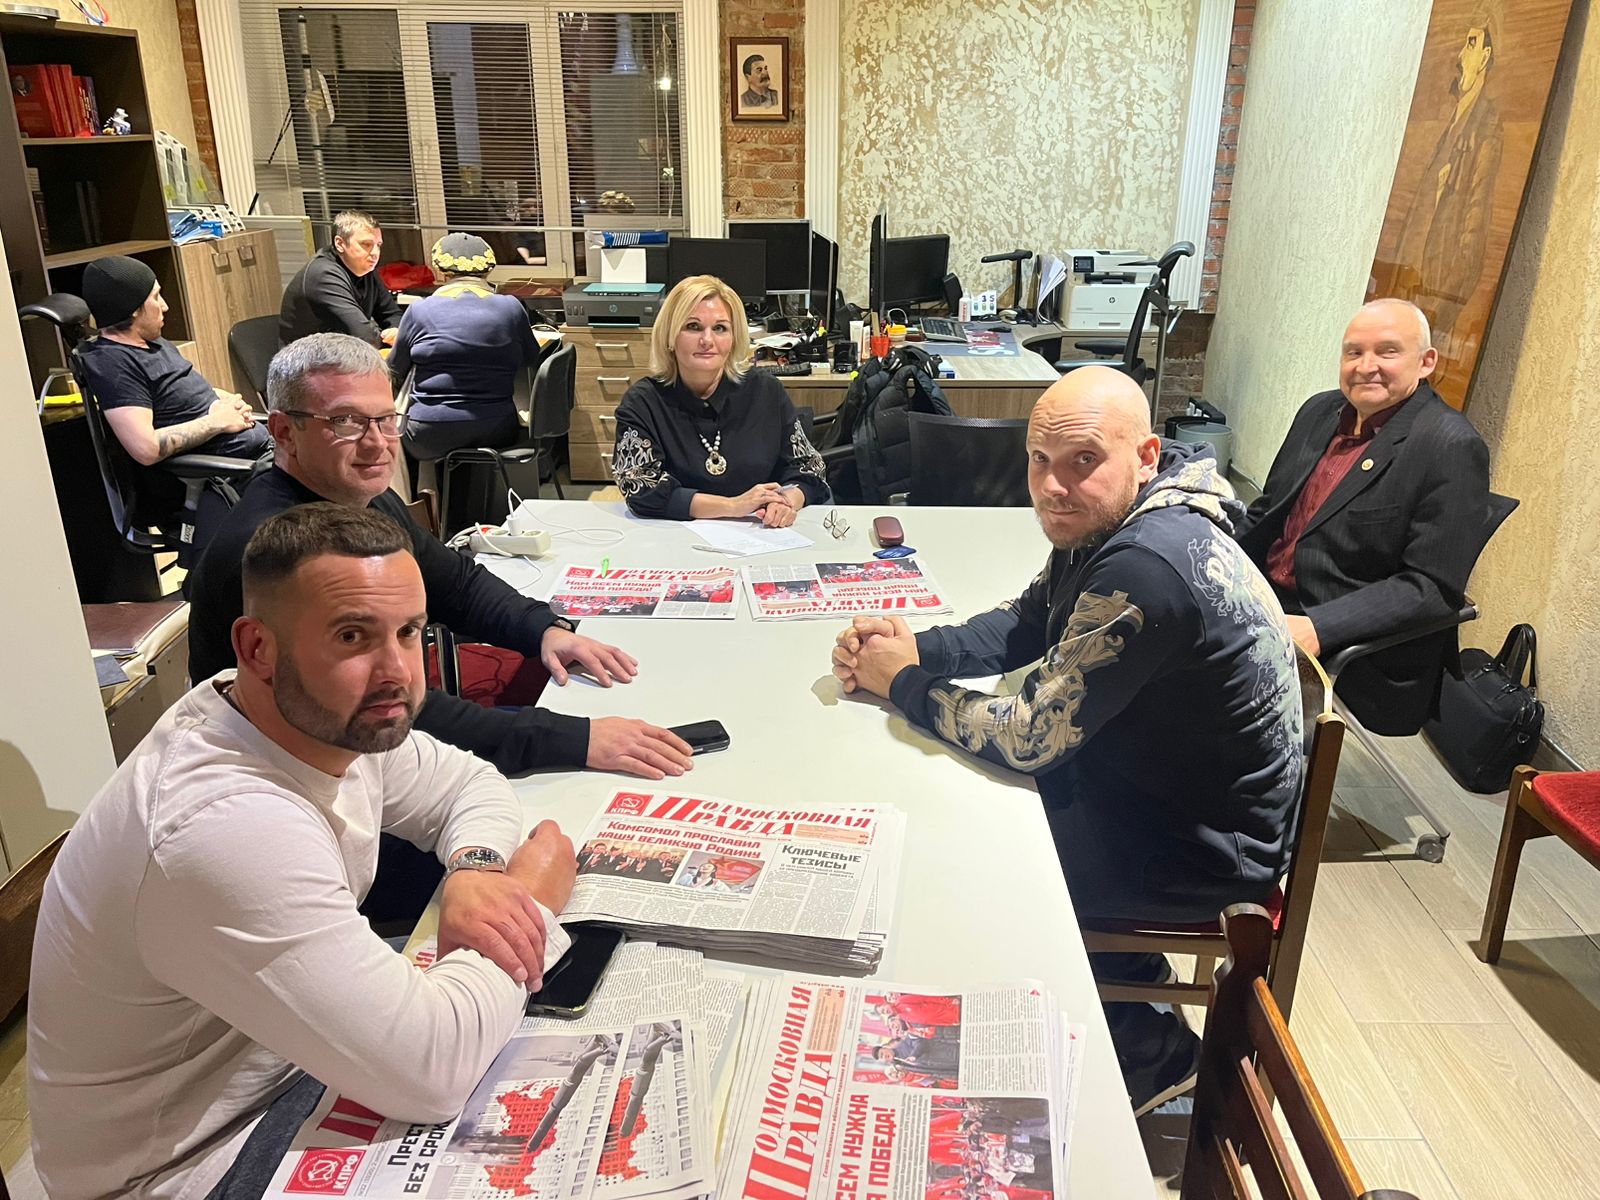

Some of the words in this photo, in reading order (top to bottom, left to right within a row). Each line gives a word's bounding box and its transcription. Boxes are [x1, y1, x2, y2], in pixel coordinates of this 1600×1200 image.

[842, 1094, 869, 1158] НУЖНА
[868, 1106, 896, 1186] ПОБЕДА!
[332, 1154, 359, 1190] КПРФ
[403, 1162, 430, 1193] БЕЗ
